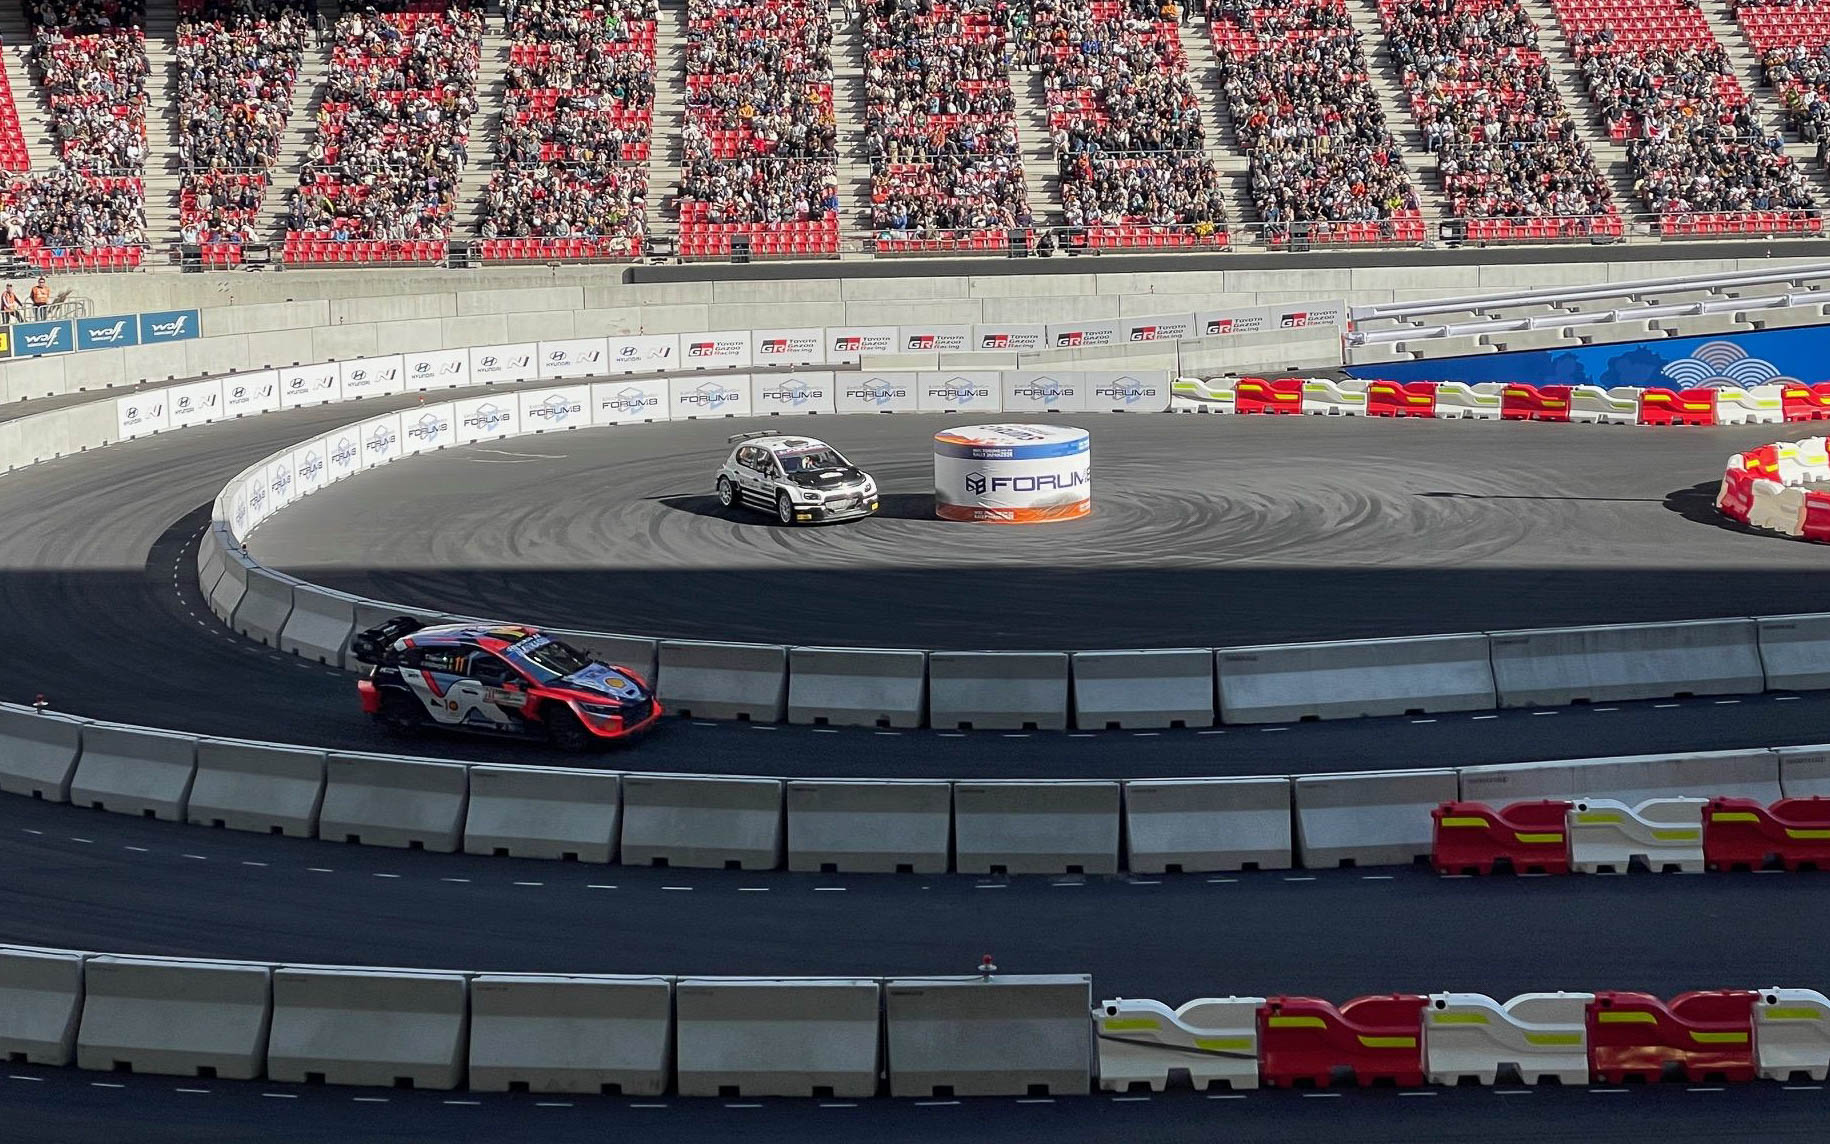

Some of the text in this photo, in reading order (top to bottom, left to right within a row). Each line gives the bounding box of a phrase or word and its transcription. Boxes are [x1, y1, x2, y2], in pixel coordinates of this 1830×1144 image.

[1281, 318, 1306, 328] GR
[1207, 325, 1231, 335] GR
[1130, 332, 1155, 341] GR
[835, 342, 860, 351] GR
[908, 340, 933, 349] GR
[982, 339, 1007, 348] GR
[1057, 337, 1082, 347] GR
[689, 347, 714, 357] GR
[761, 344, 786, 353] GR
[347, 380, 371, 388] HYUNDAI
[680, 393, 739, 403] FORUM8
[763, 390, 823, 399] FORUM8
[846, 390, 906, 398] FORUM8
[928, 389, 989, 397] FORUM8
[602, 398, 658, 410] FORUM8
[529, 405, 581, 417] FORUM8
[464, 413, 510, 427] FORUM8
[408, 423, 448, 438] FORUM8
[366, 435, 396, 450] FORUM8
